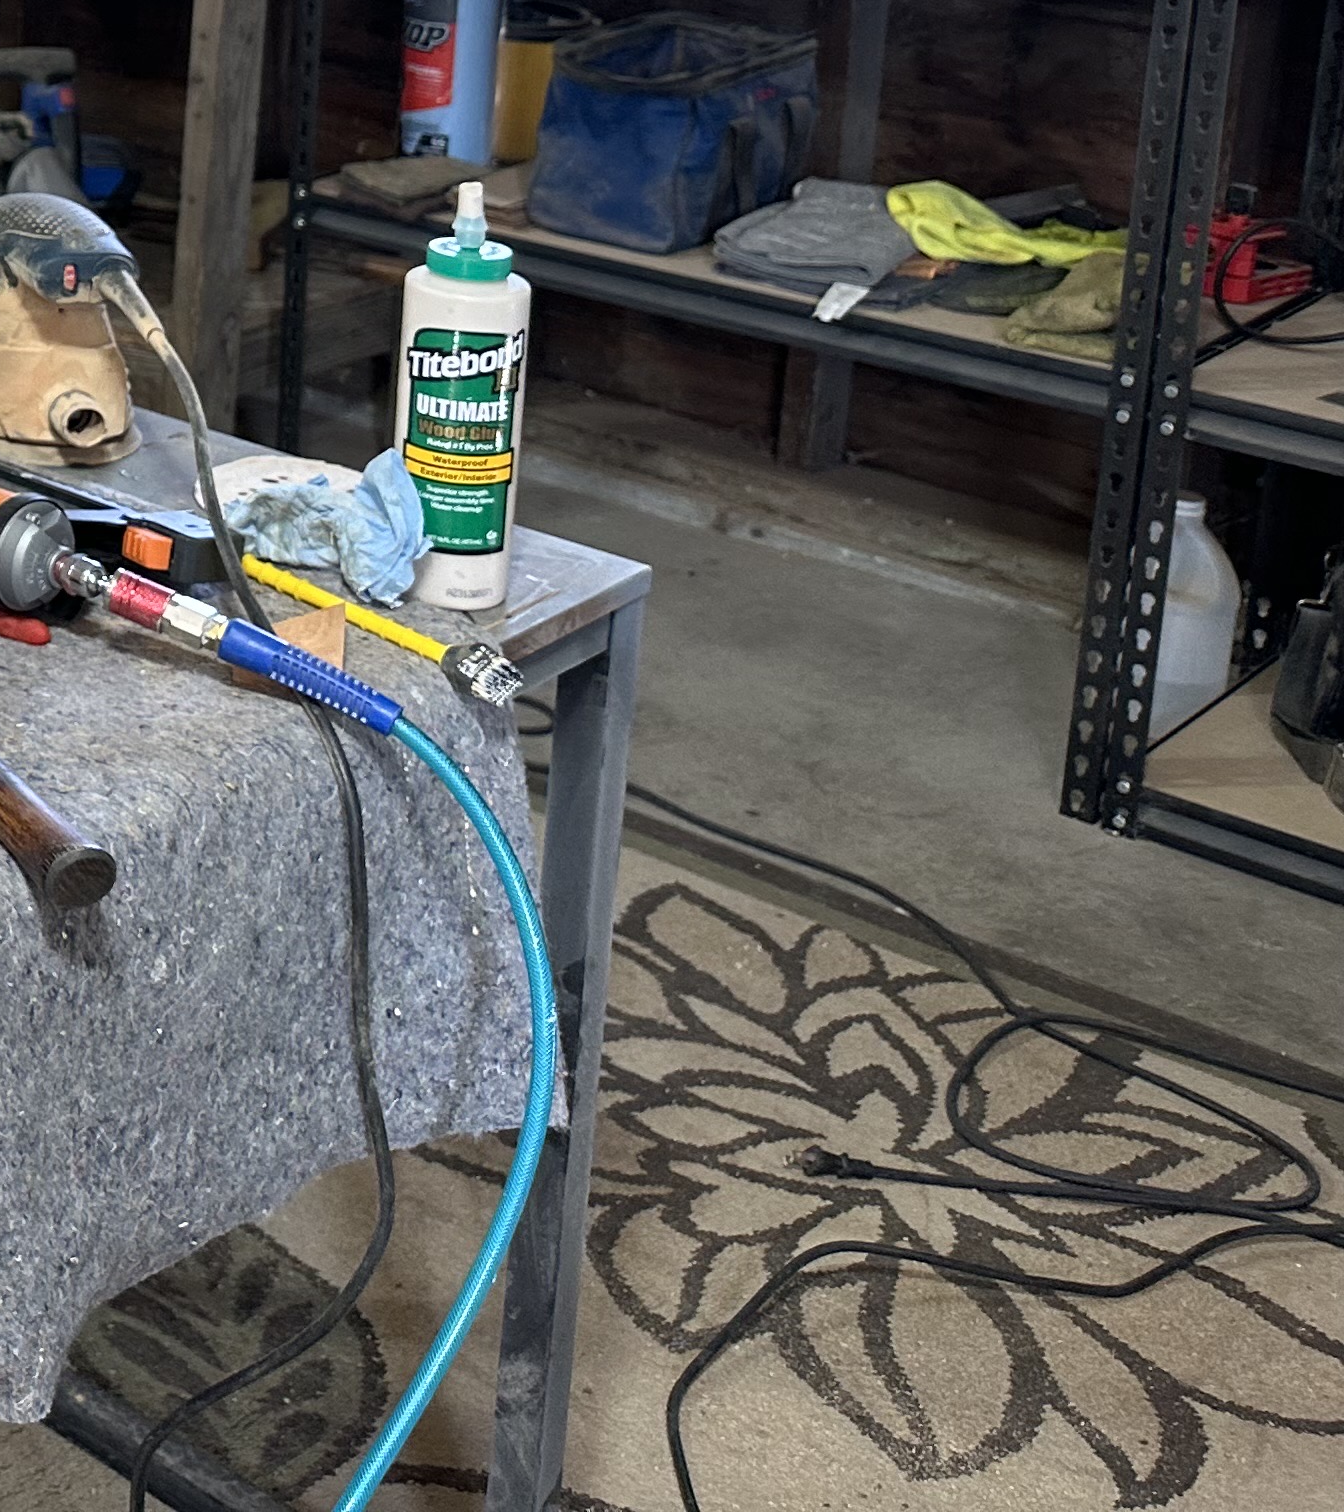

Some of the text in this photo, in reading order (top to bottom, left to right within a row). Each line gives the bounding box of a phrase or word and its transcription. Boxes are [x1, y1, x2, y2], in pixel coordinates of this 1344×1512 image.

[408, 332, 524, 379] Titebond
[416, 392, 509, 423] ULTIMATE
[419, 418, 466, 440] Wood
[432, 454, 489, 467] Waterproof
[420, 467, 497, 482] Exterior/Interior
